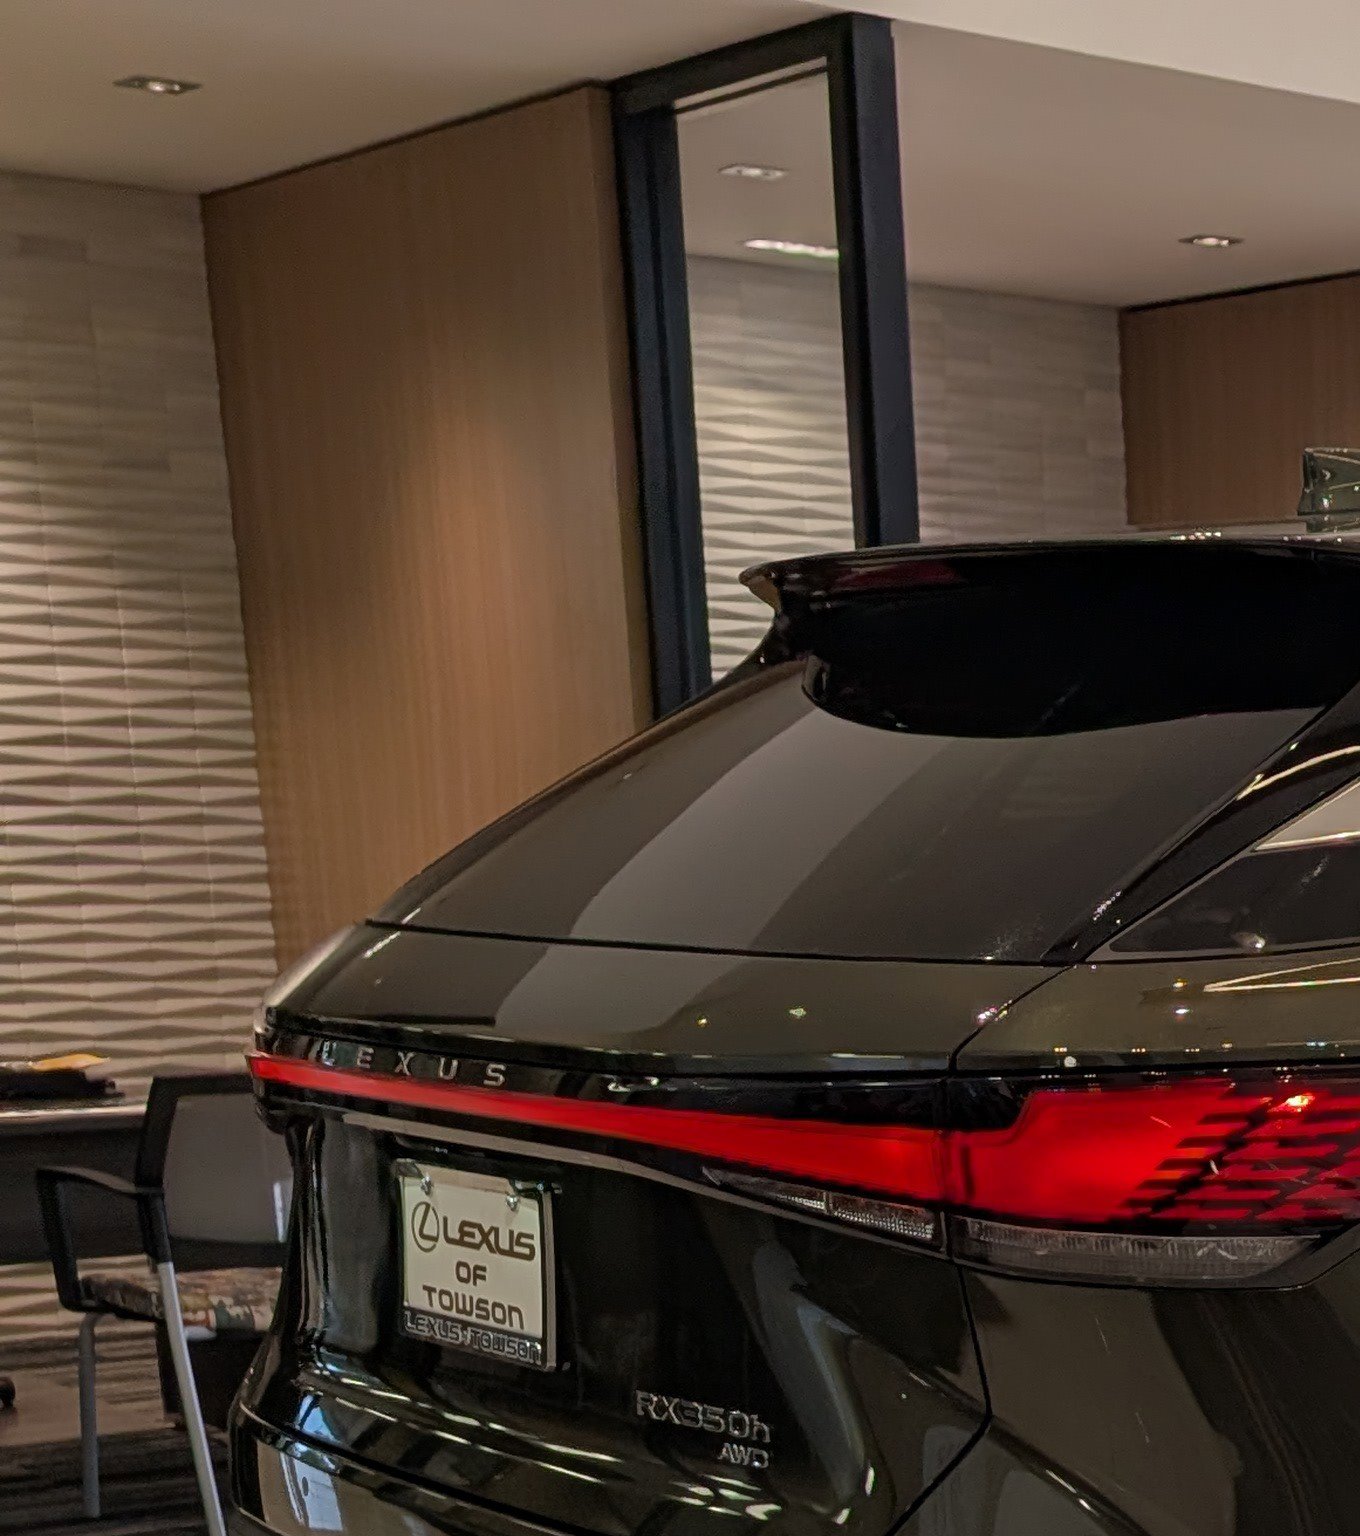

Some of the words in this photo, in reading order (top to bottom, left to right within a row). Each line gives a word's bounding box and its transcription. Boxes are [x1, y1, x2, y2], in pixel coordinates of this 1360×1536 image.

[320, 1038, 507, 1088] LEXUS
[442, 1214, 536, 1262] LEXUS
[455, 1260, 488, 1287] OF
[404, 1310, 461, 1344] LEXUS
[422, 1284, 526, 1331] TOWSON
[635, 1389, 772, 1444] RX350h
[716, 1442, 770, 1469] AWD
